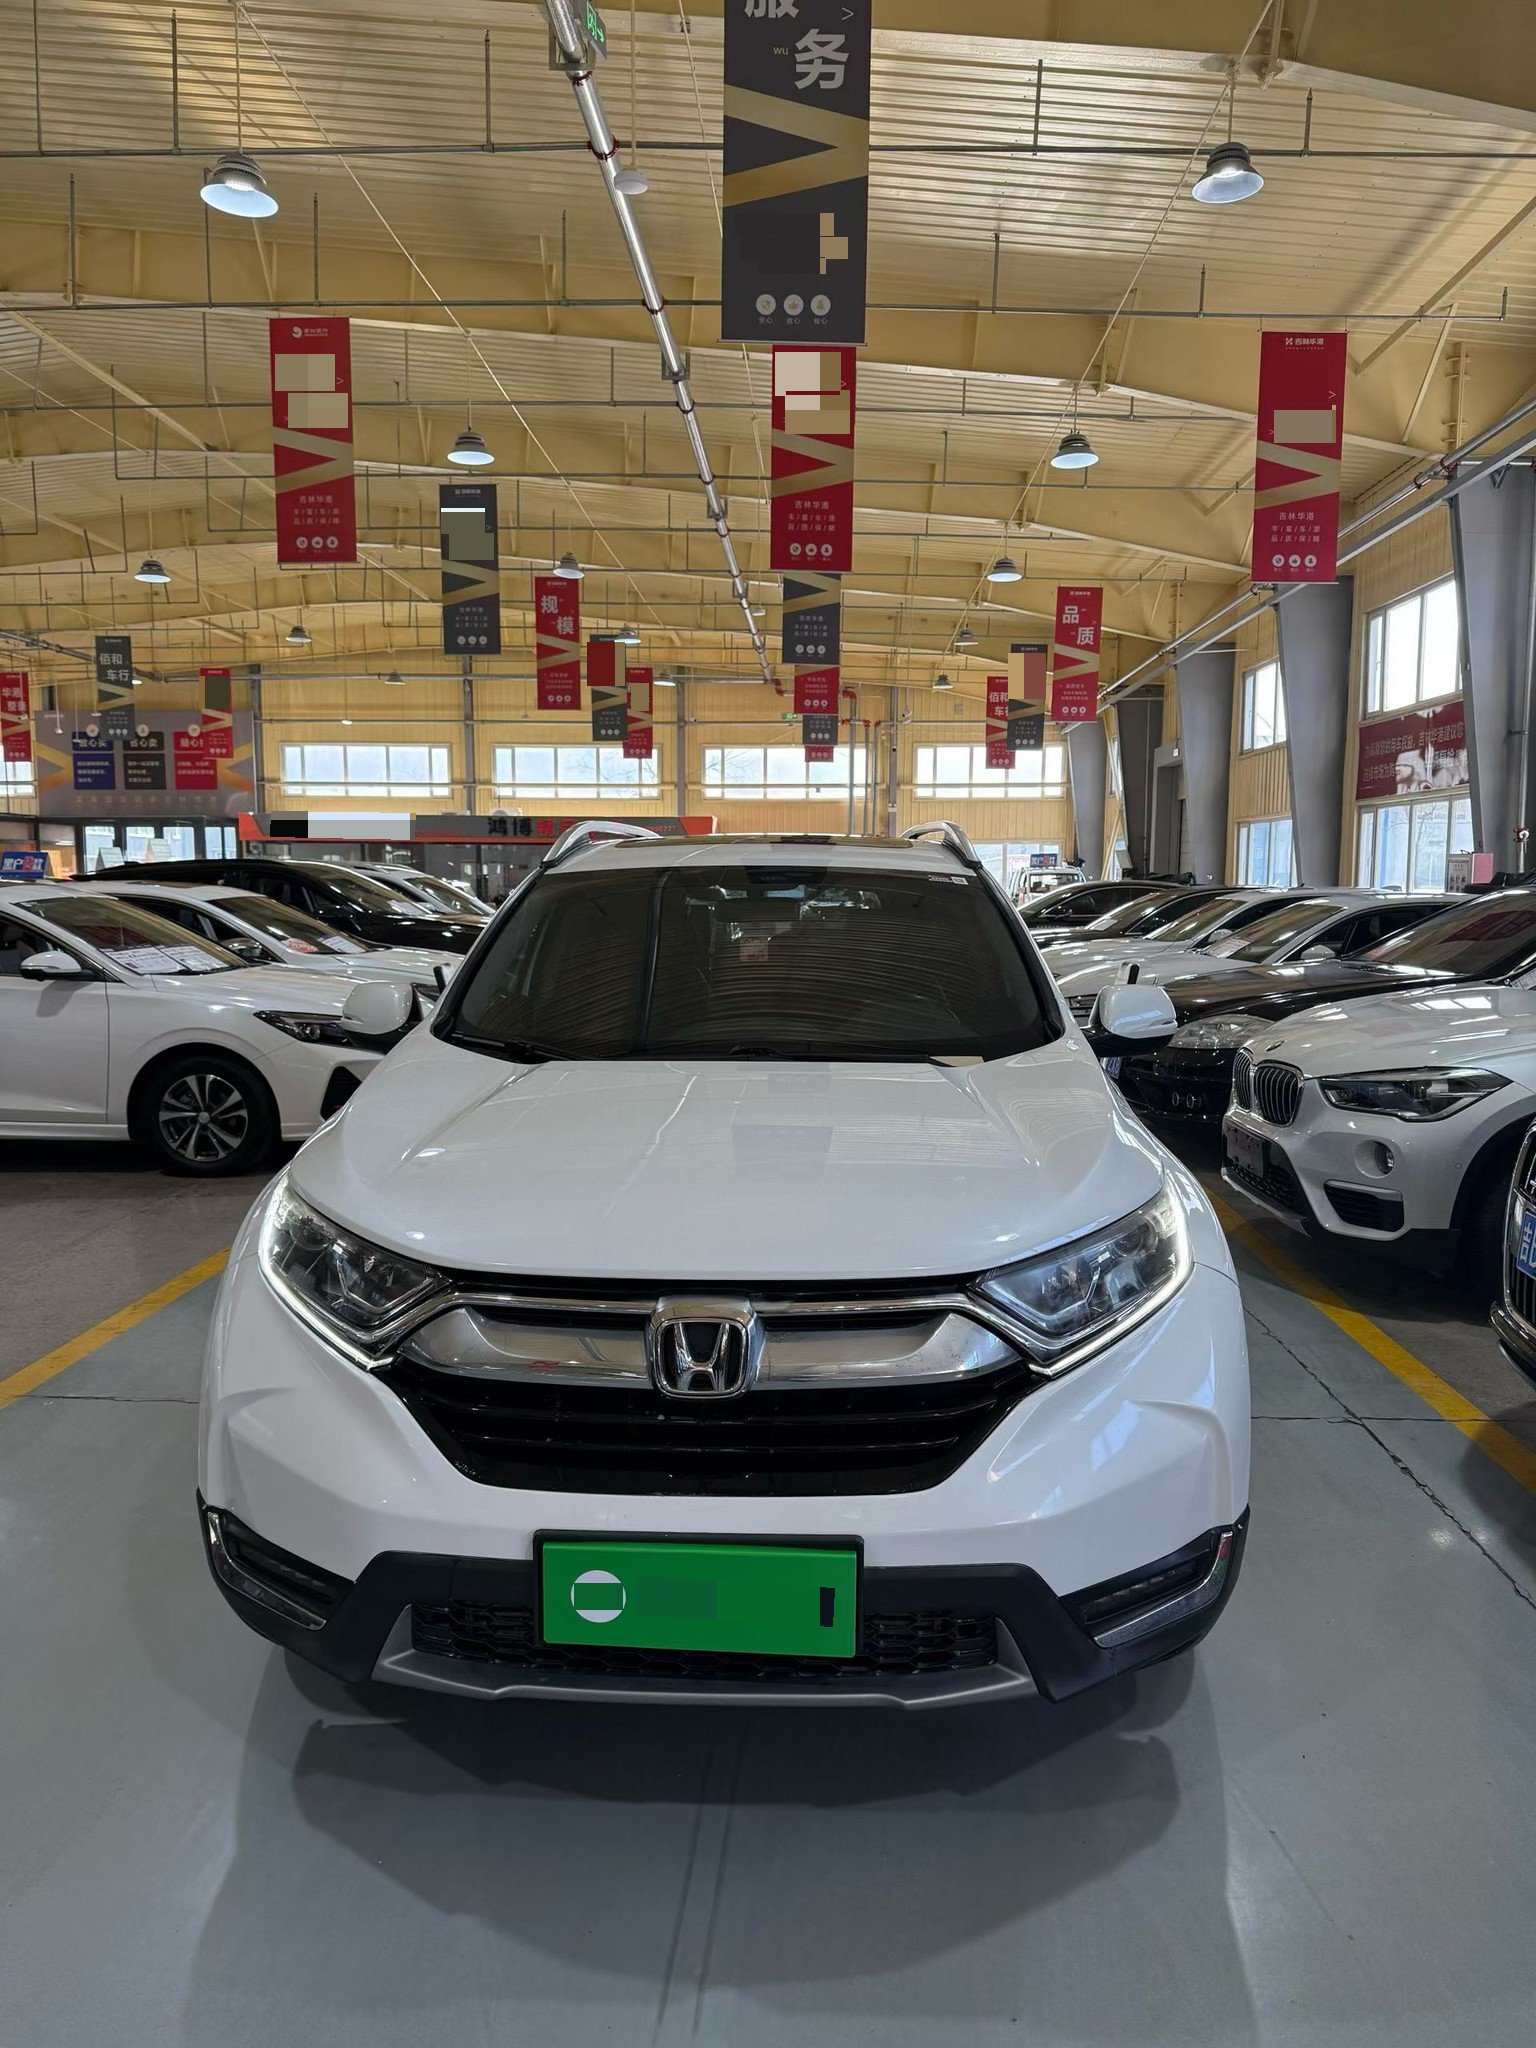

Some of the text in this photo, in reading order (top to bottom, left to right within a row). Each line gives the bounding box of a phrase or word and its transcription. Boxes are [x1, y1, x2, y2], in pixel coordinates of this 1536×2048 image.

[795, 28, 850, 90] 务
[1279, 511, 1315, 521] 吉林华港
[541, 595, 559, 614] 规
[1062, 605, 1080, 624] 品
[557, 616, 574, 635] 模
[1077, 626, 1095, 646] 质
[99, 653, 124, 666] 佰和
[106, 669, 129, 682] 车行
